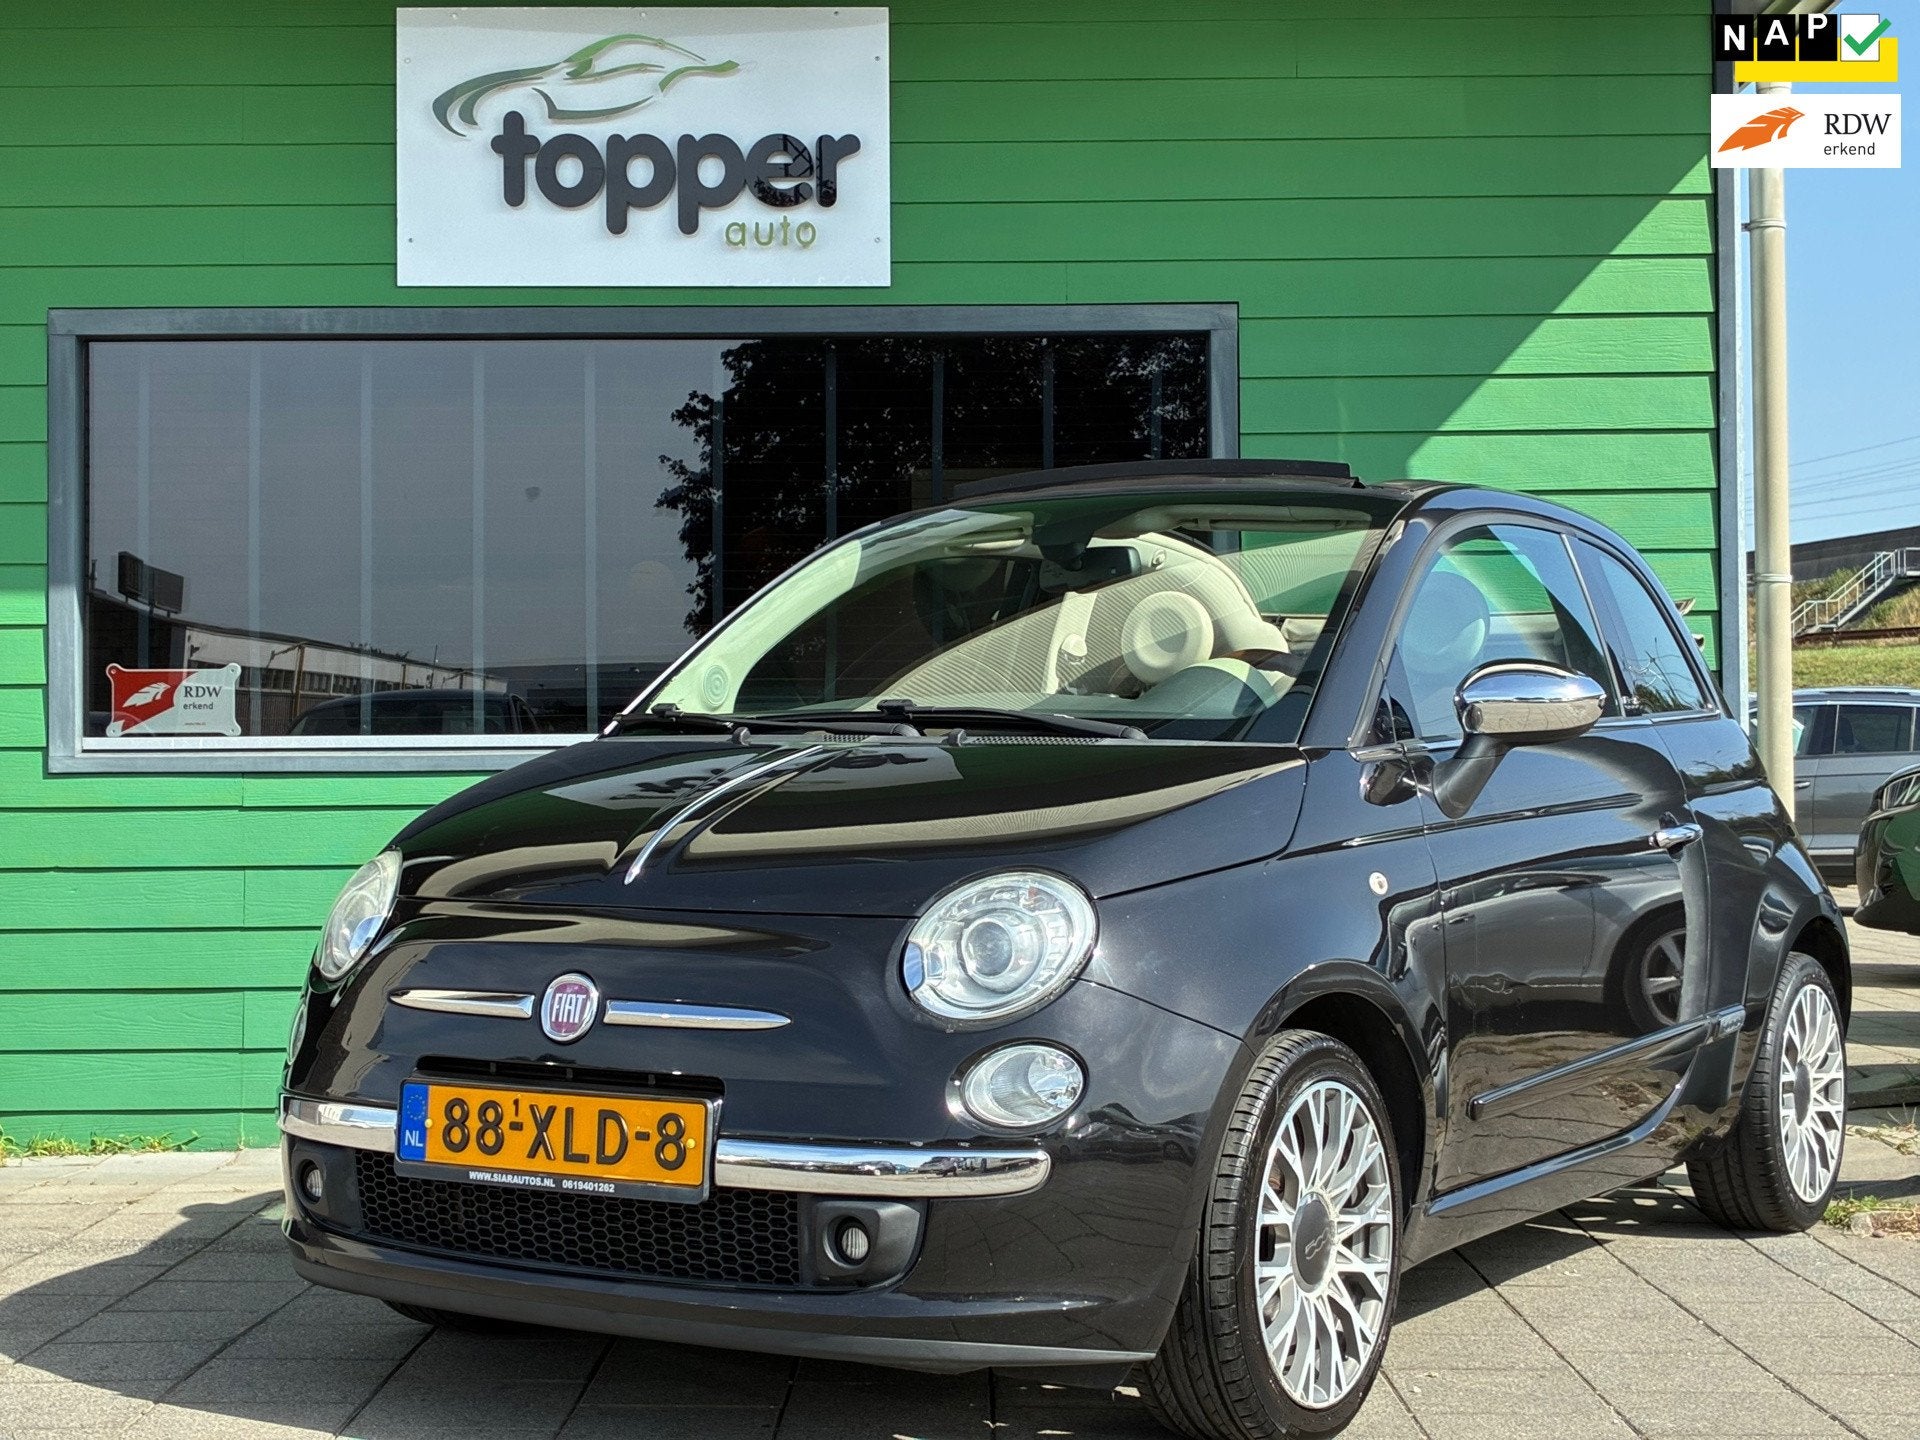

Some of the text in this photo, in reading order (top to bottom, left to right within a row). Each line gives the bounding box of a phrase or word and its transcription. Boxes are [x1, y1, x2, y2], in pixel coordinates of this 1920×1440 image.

[490, 110, 861, 236] topper
[724, 215, 817, 247] auto
[183, 685, 222, 699] RDW
[182, 701, 214, 711] erkend
[551, 993, 587, 1023] FIAT
[404, 1129, 424, 1148] NL
[468, 1170, 615, 1193] WWW.SIARAUTOS.NL 0619401262
